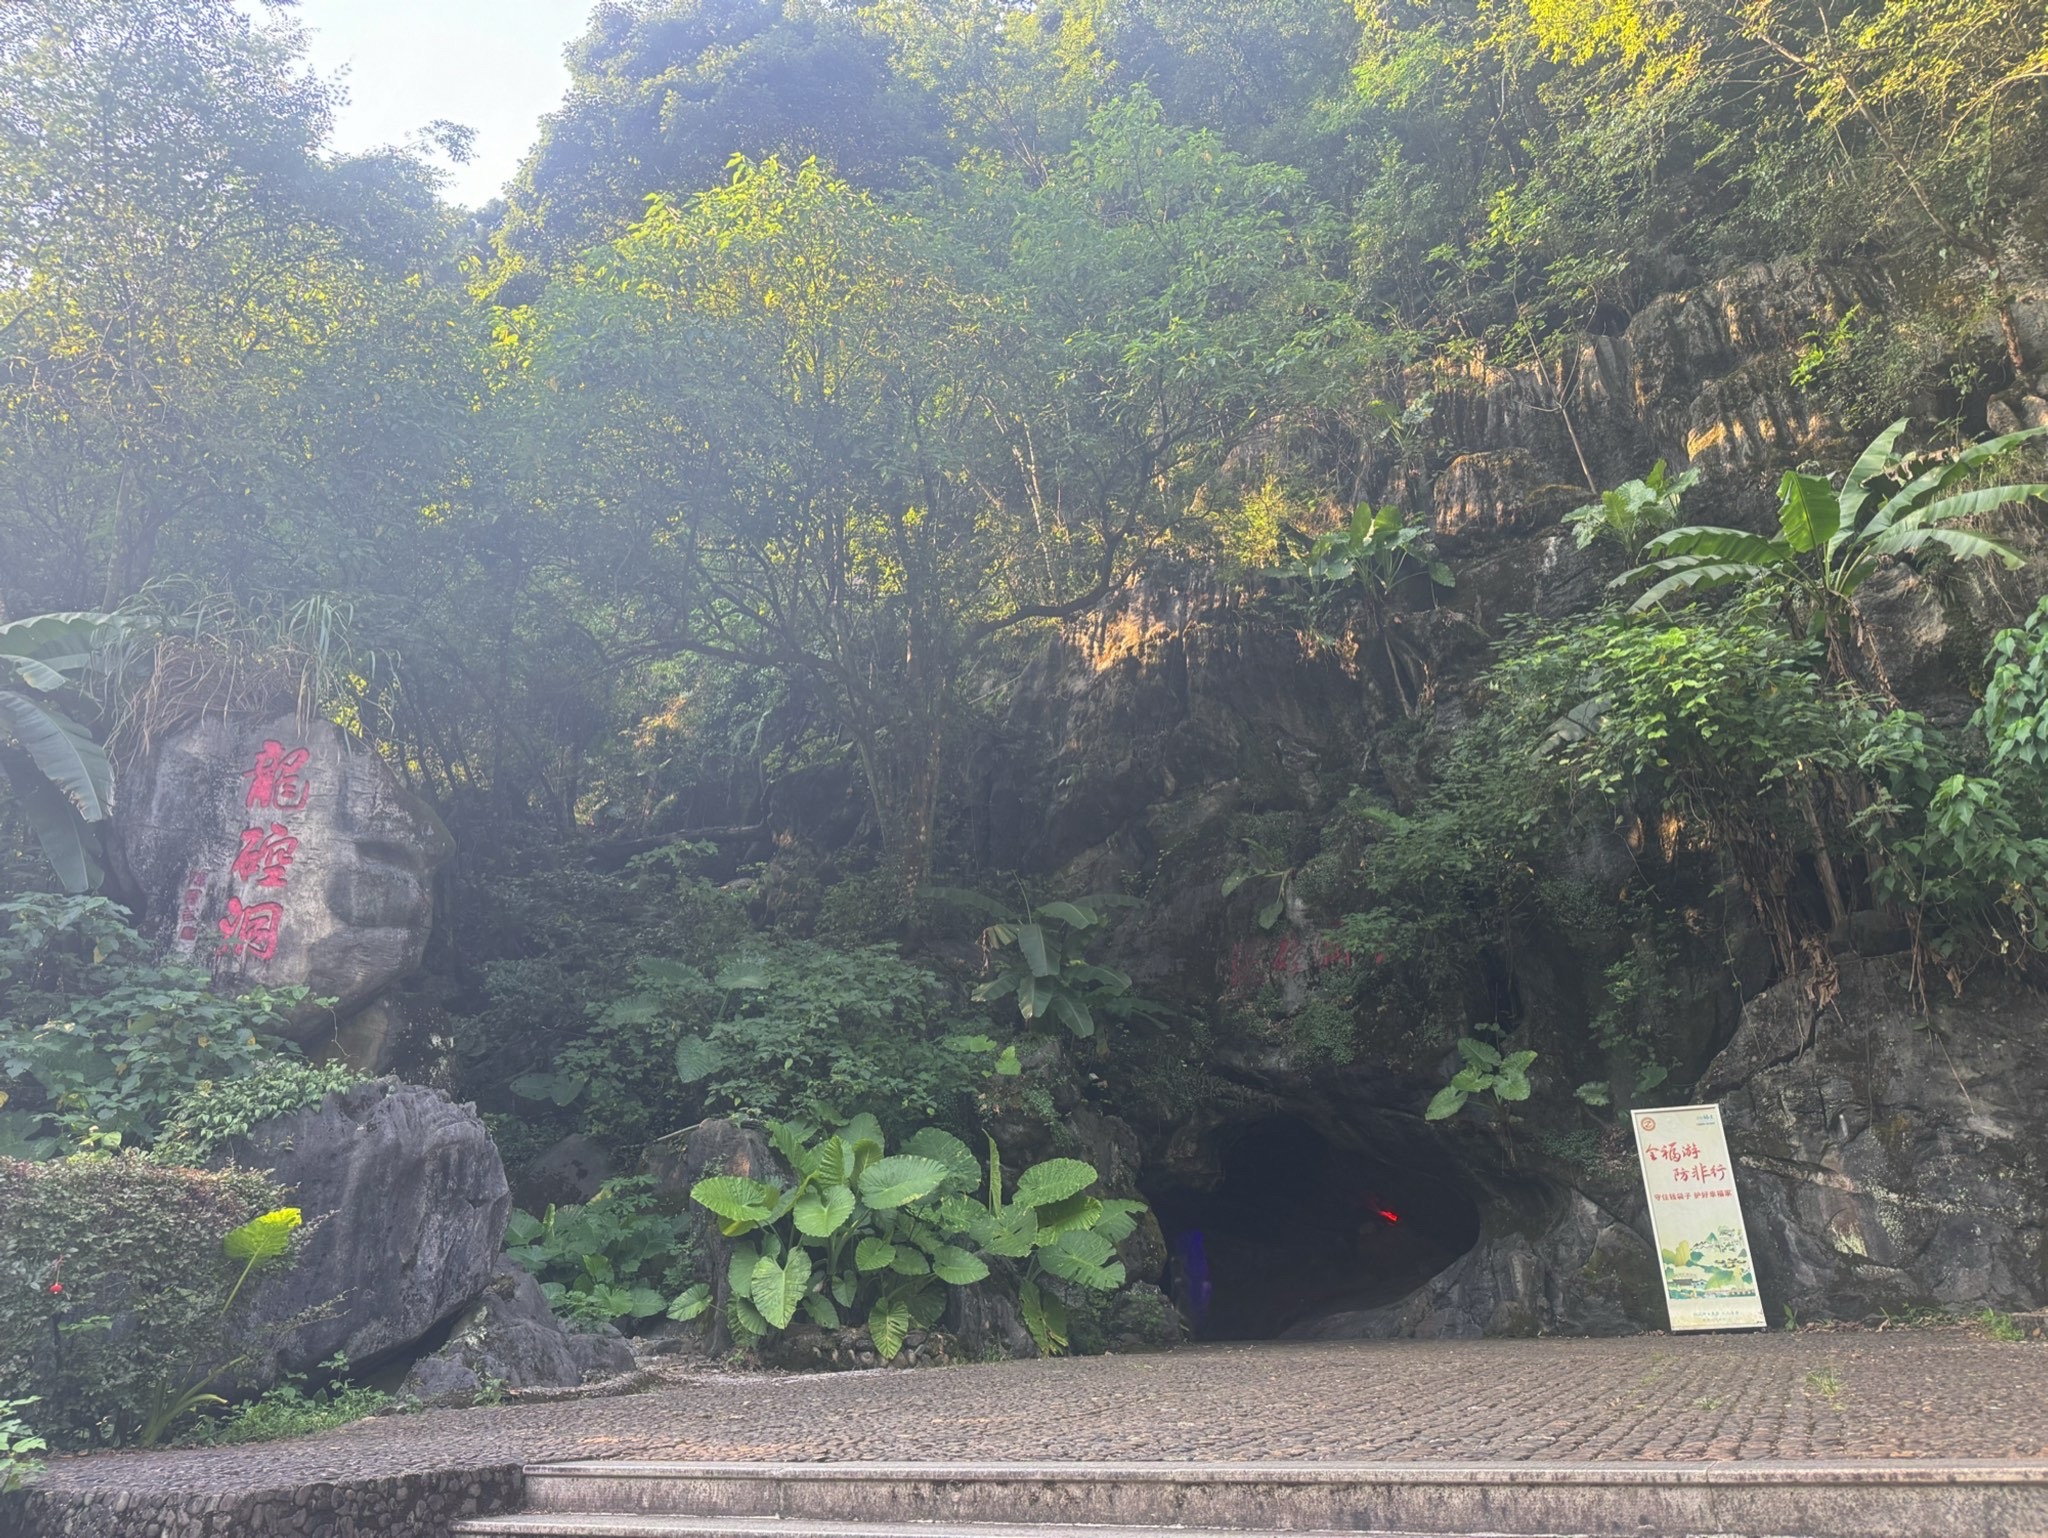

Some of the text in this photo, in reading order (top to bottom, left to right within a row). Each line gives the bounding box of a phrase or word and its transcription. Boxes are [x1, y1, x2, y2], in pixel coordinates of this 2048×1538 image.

[1645, 1142, 1701, 1162] 全福游
[1673, 1162, 1727, 1184] 防非行
